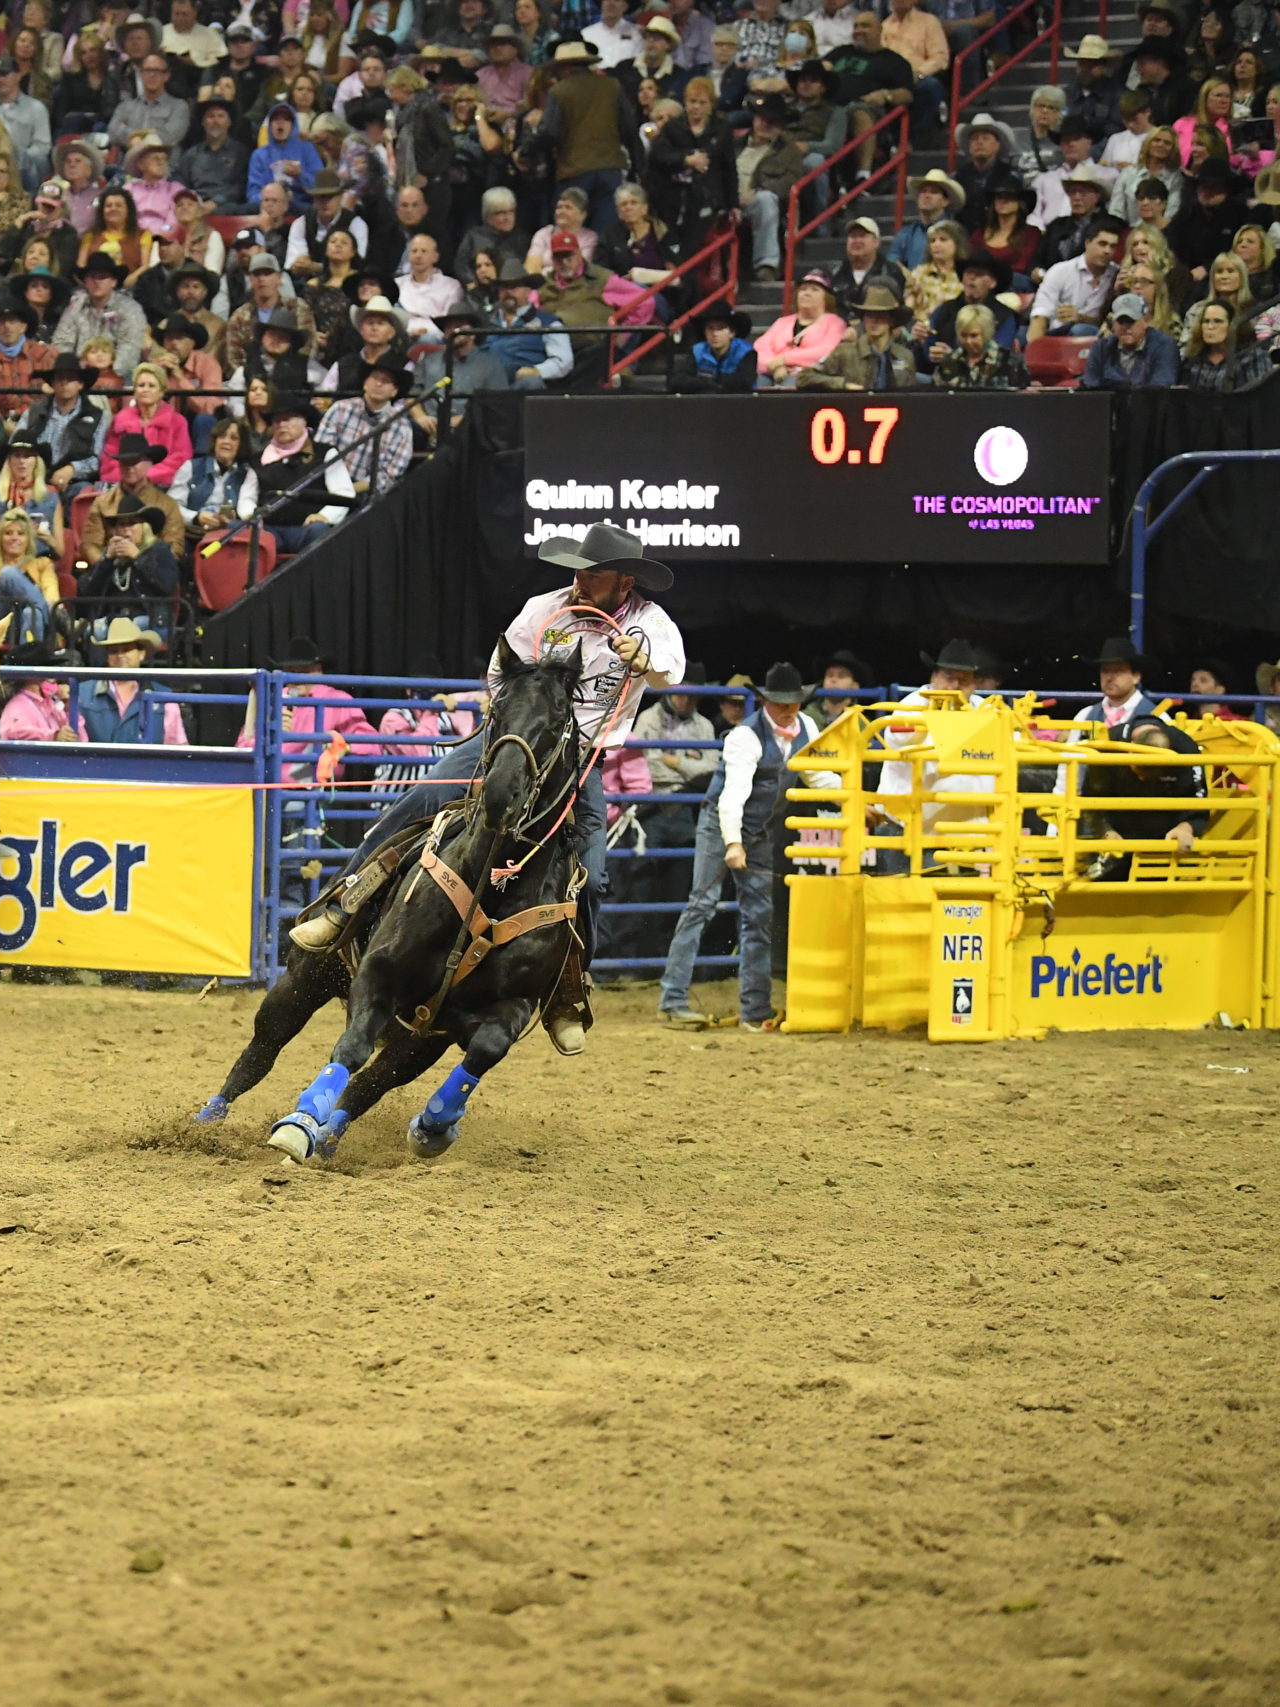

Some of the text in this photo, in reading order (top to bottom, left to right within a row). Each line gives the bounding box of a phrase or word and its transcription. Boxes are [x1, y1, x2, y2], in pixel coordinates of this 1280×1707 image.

[811, 407, 899, 464] 0.7
[526, 479, 719, 510] Quinn Kesler
[913, 496, 1092, 515] THE COSMOPOLITAN
[627, 518, 740, 546] Harrison
[440, 871, 458, 890] SVE
[538, 909, 556, 919] SVE
[943, 905, 983, 925] Wrangler
[943, 935, 983, 961] NFR
[1031, 947, 1163, 998] Priefert
